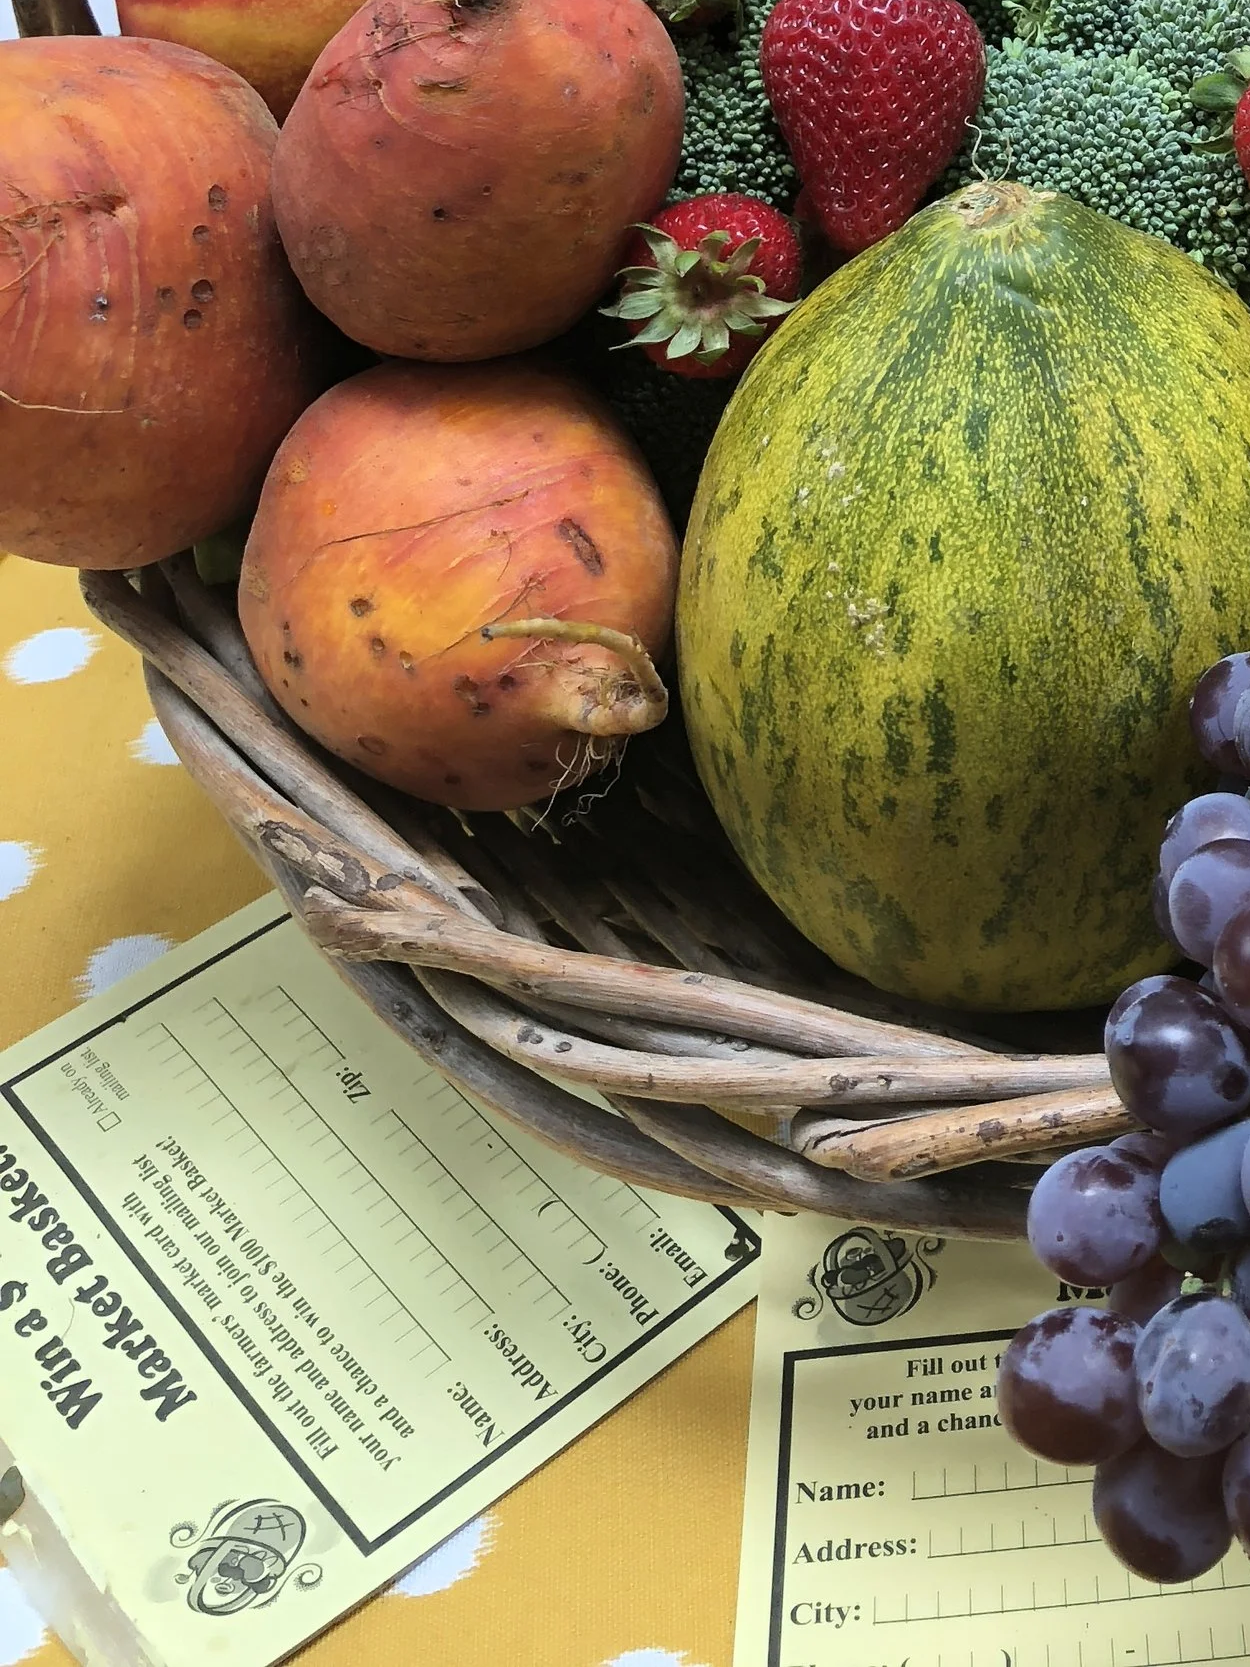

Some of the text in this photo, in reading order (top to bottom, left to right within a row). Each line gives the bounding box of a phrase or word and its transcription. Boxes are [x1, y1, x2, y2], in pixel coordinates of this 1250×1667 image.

[60, 1061, 109, 1115] Already on
[95, 1063, 130, 1100] mailing
[336, 1067, 371, 1104] Zip:
[122, 1192, 152, 1226] with
[144, 1224, 180, 1258] card
[650, 1228, 708, 1288] Email:
[156, 1136, 414, 1438] and a chance to win the $100 Market Basket!
[172, 1257, 222, 1312] market
[599, 1262, 660, 1327] Phone:
[14, 1308, 48, 1338] a
[132, 1154, 401, 1472] your name and address to join our mailing list
[74, 1275, 198, 1422] Market
[563, 1315, 606, 1362] City:
[484, 1324, 558, 1401] Address:
[906, 1357, 943, 1378] Fill
[951, 1354, 987, 1374] out
[34, 1335, 103, 1430] Win
[268, 1374, 293, 1402] the
[285, 1399, 315, 1427] out
[447, 1382, 504, 1448] Name:
[849, 1393, 904, 1418] your
[911, 1387, 972, 1406] name
[306, 1426, 340, 1461] Fill
[866, 1412, 1002, 1439] and a chanc
[794, 1480, 885, 1504] Name:
[792, 1538, 917, 1564] Address:
[790, 1601, 861, 1629] City:
